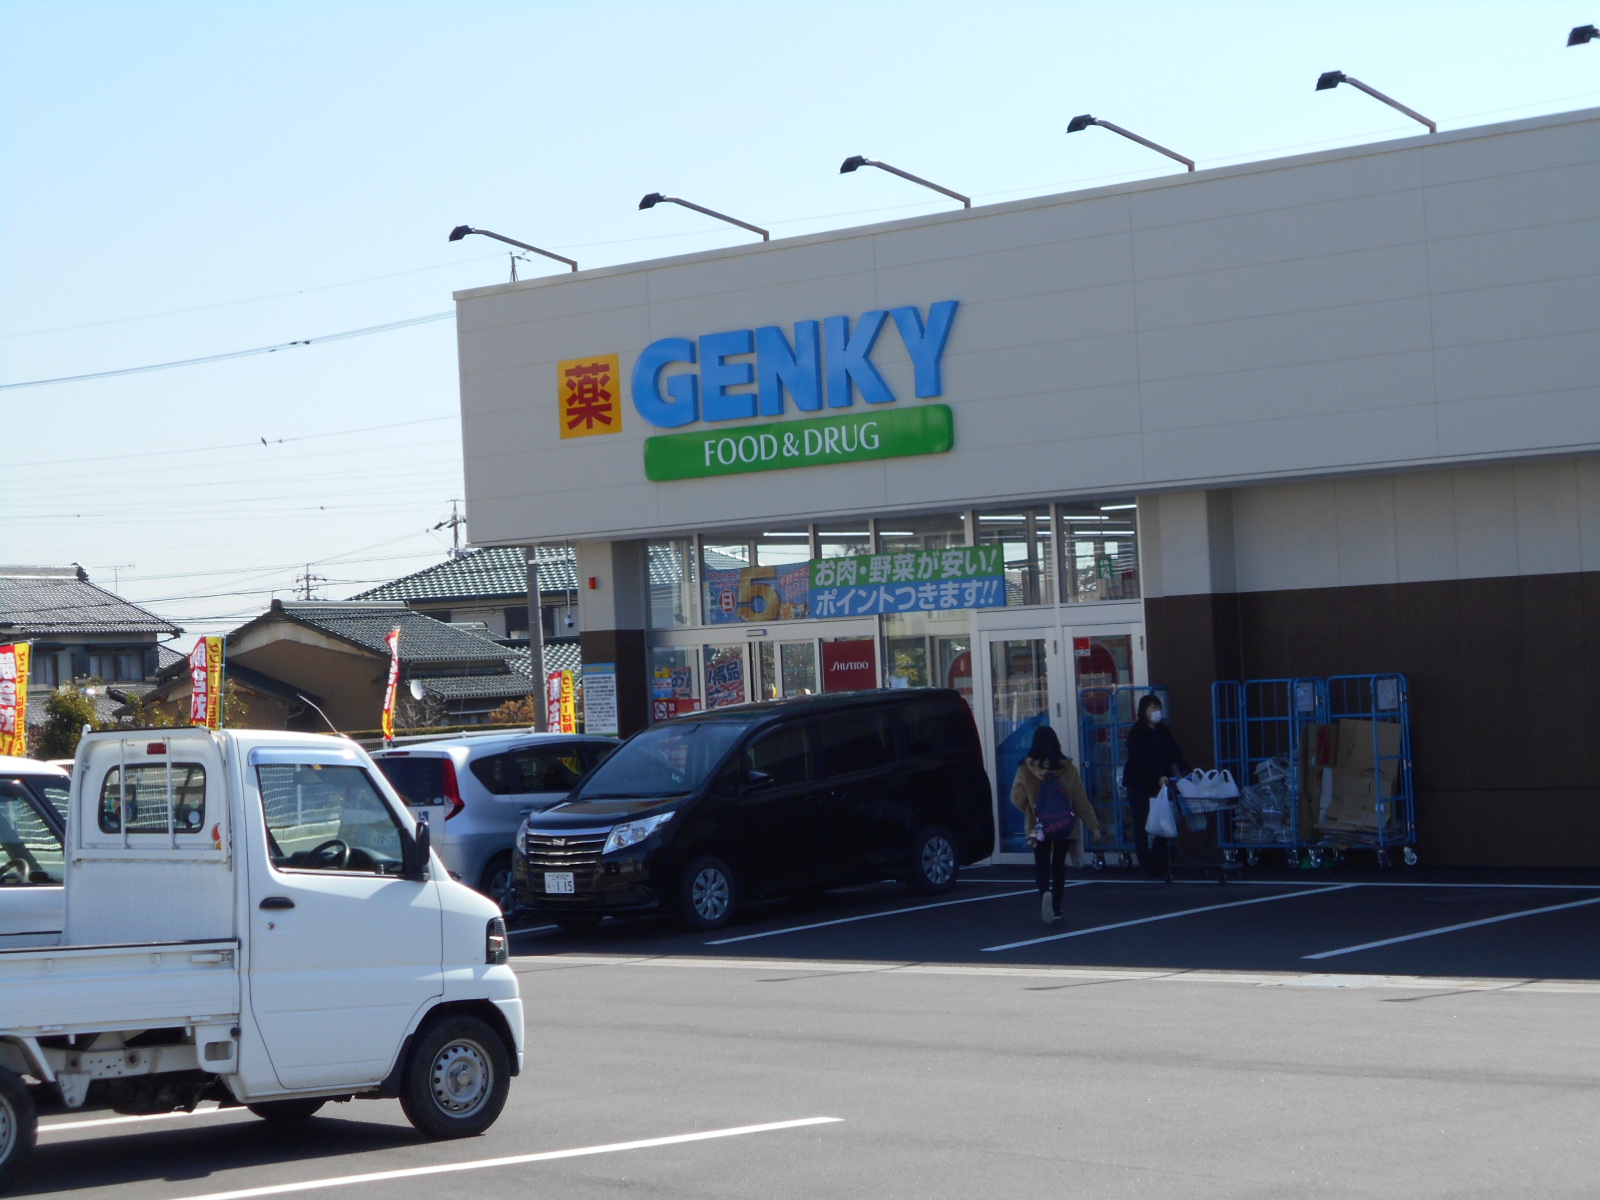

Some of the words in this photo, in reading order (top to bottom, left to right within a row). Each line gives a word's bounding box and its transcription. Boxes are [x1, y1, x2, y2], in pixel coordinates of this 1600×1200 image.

[631, 300, 960, 429] GENKY
[565, 362, 613, 430] 薬
[736, 566, 780, 622] 5
[830, 660, 869, 672] SHISEIDO
